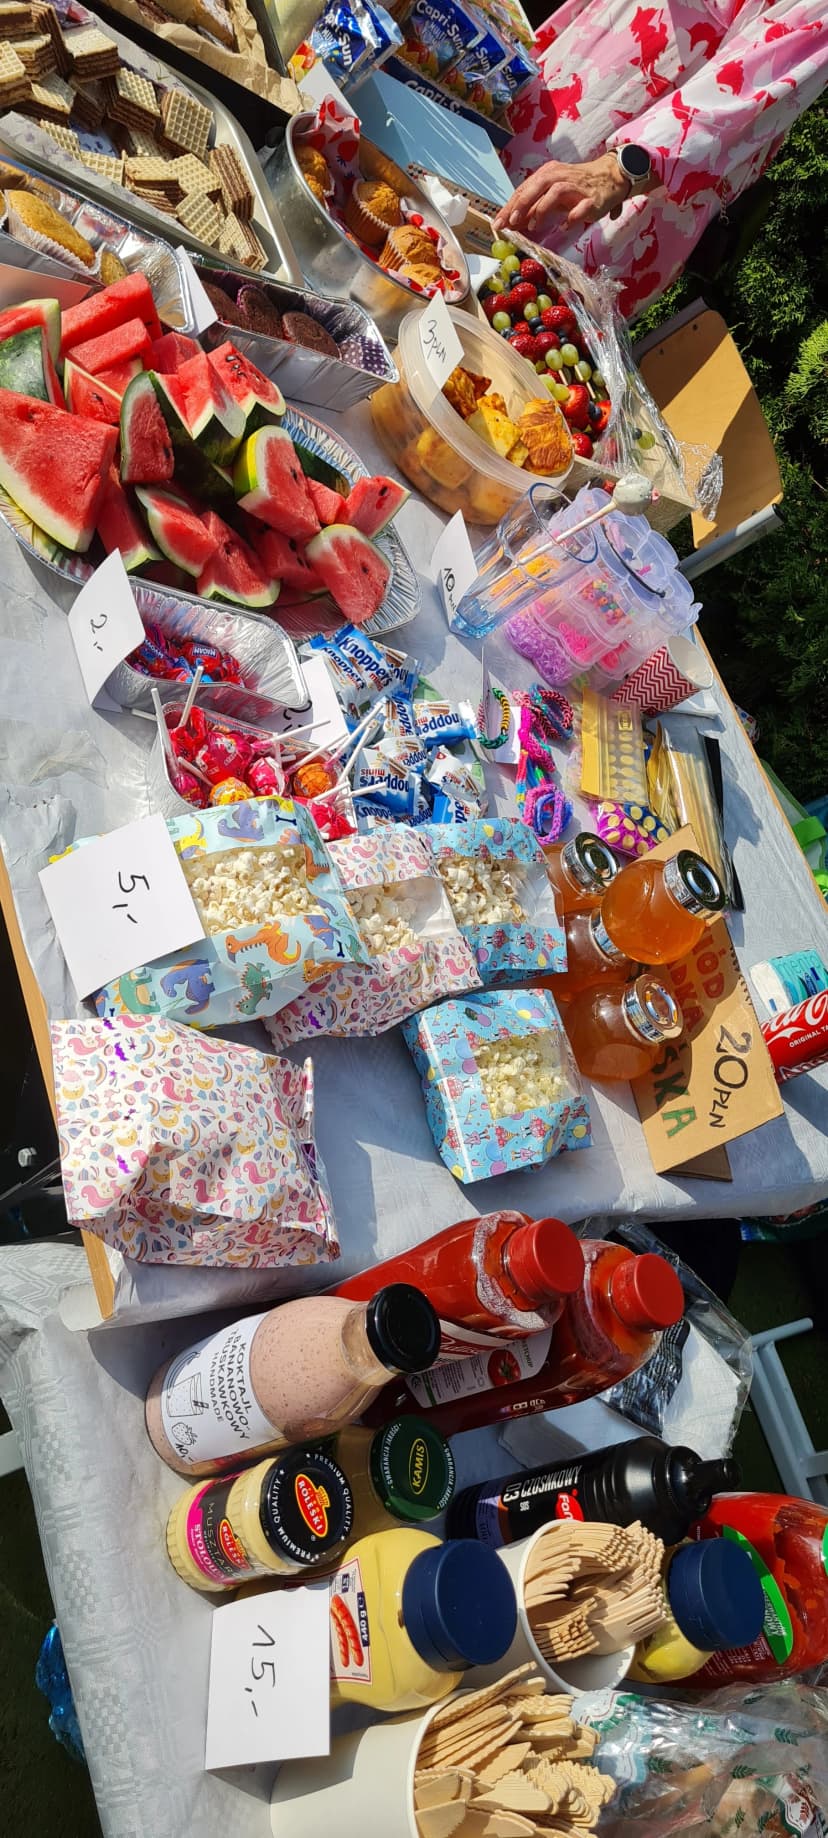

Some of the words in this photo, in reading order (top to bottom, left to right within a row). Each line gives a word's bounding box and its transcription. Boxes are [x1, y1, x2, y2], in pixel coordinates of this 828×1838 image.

[323, 647, 366, 690] Knoppers
[339, 636, 393, 687] Knoppers
[360, 768, 386, 777] minis
[789, 1030, 821, 1048] ORIGINAL
[209, 1352, 225, 1423] HANDMADE
[236, 1342, 253, 1414] KOKTAJL
[411, 1443, 426, 1489] KAMIS
[521, 1464, 583, 1499] CZOSNKOWY
[271, 1477, 282, 1524] QUALITY
[297, 1479, 324, 1532] ROLESKI
[313, 1452, 346, 1486] PREMIUM
[342, 1487, 353, 1533] QUALITY
[519, 1501, 530, 1511] SOS
[276, 1526, 312, 1561] PREMIUM
[359, 1619, 370, 1642] 440
